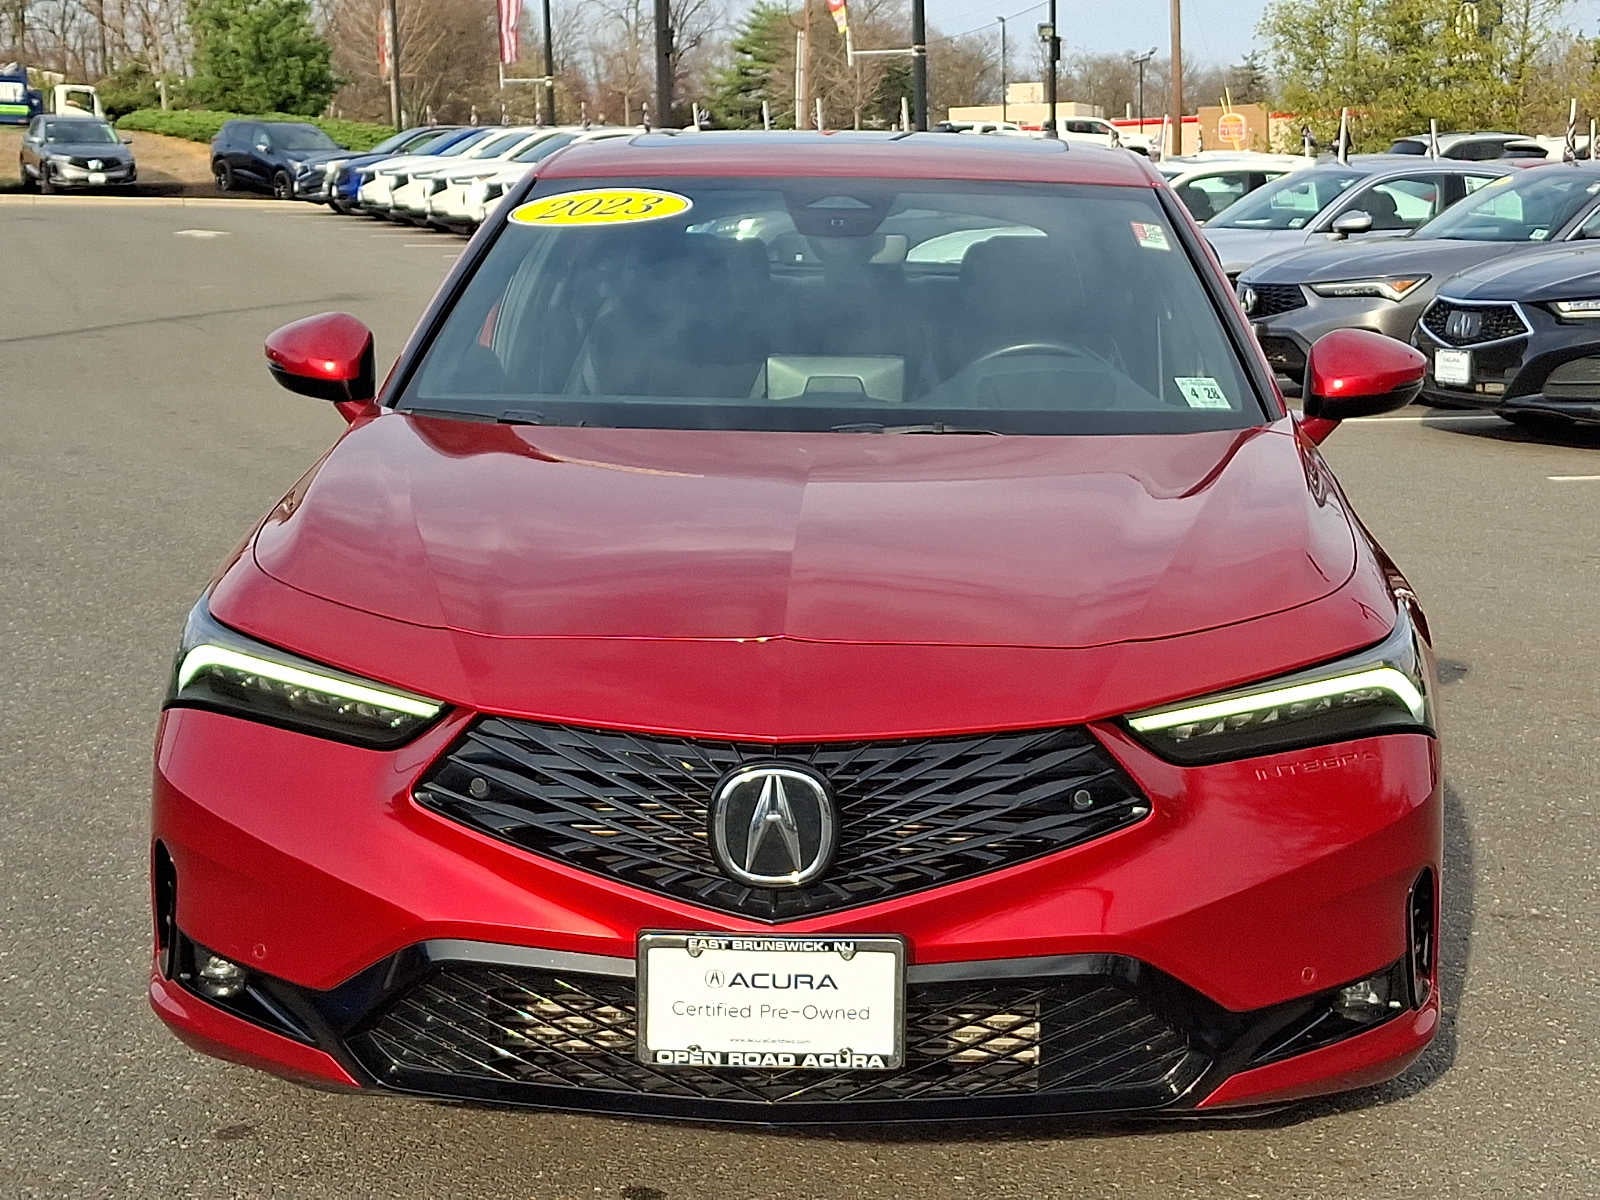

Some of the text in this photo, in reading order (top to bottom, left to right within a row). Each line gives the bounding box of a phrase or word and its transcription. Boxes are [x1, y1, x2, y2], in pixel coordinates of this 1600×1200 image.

[535, 196, 664, 220] 2023
[1190, 387, 1200, 400] 4
[687, 938, 729, 950] EAST
[833, 941, 855, 952] NJ
[727, 972, 839, 990] ACURA
[671, 1000, 871, 1021] Certified Pre-Owned
[655, 1050, 886, 1068] OPEN ROAD ACURA
